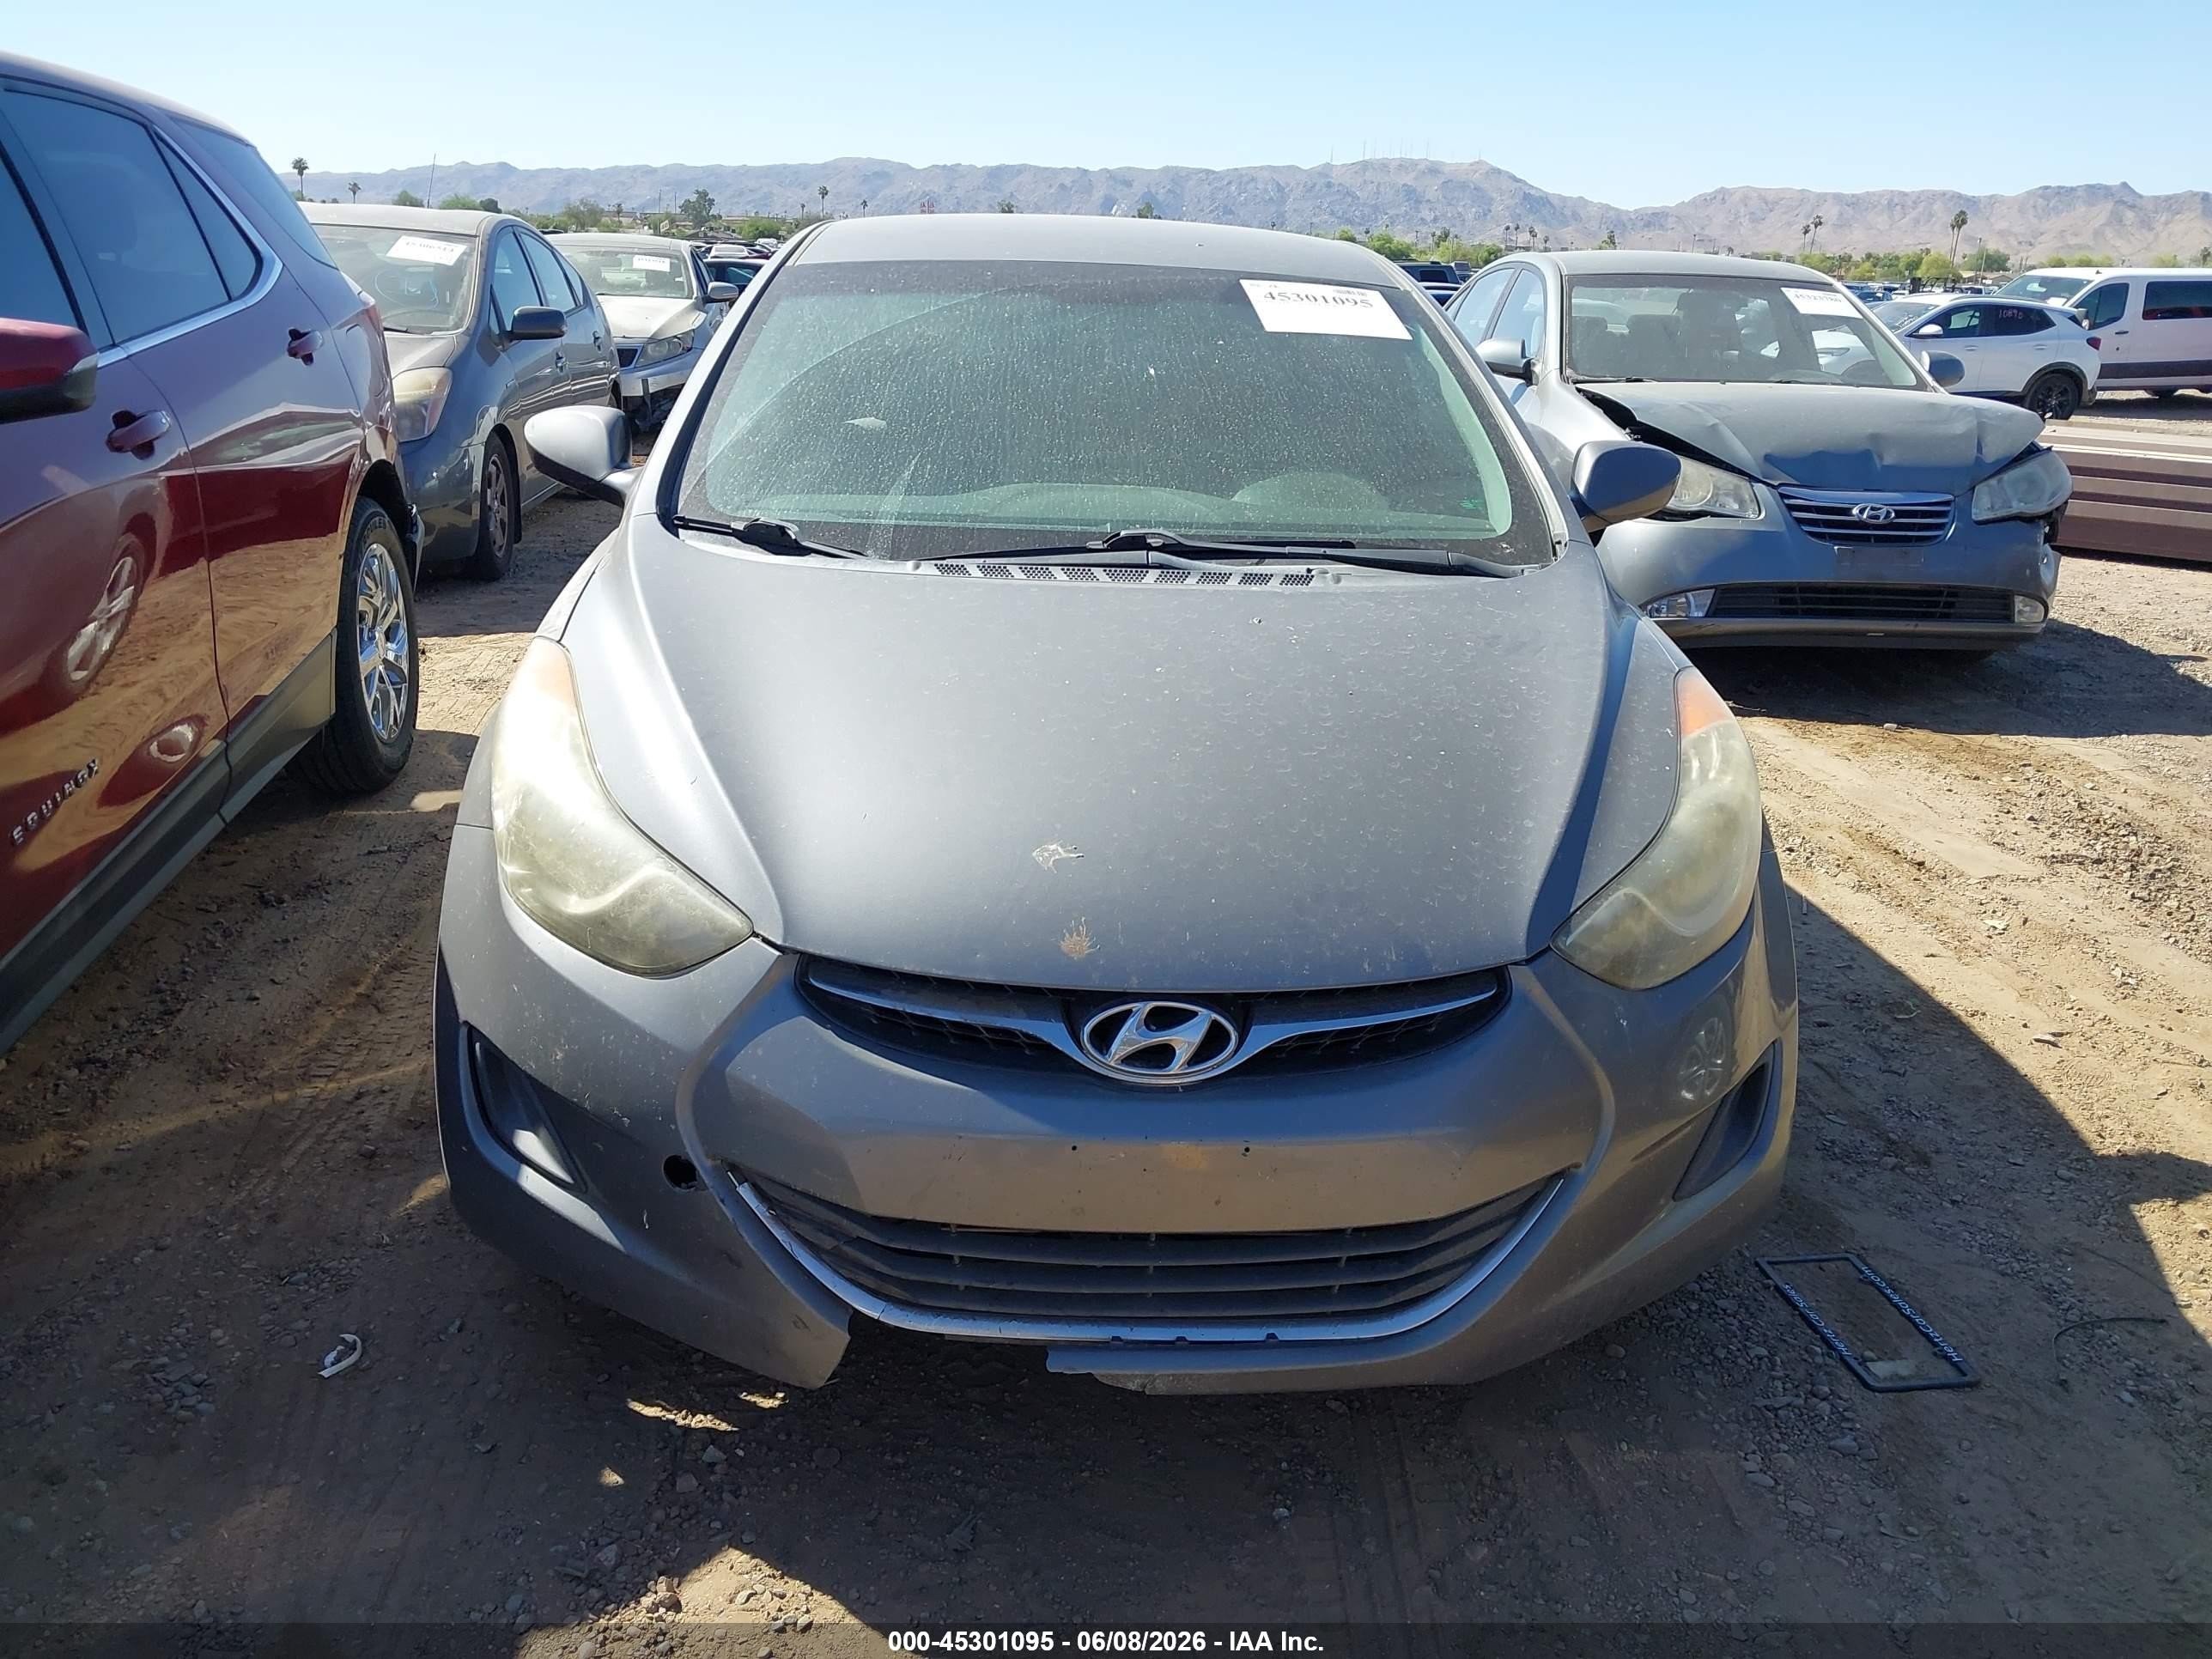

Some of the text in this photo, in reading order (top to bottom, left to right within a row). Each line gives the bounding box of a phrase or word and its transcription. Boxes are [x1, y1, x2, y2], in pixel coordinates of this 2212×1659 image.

[1263, 291, 1374, 309] 45301095
[1804, 1309, 1825, 1327] Car
[1861, 1266, 1964, 1363] HertzCarSales.com
[1822, 1328, 1853, 1355] Hertz
